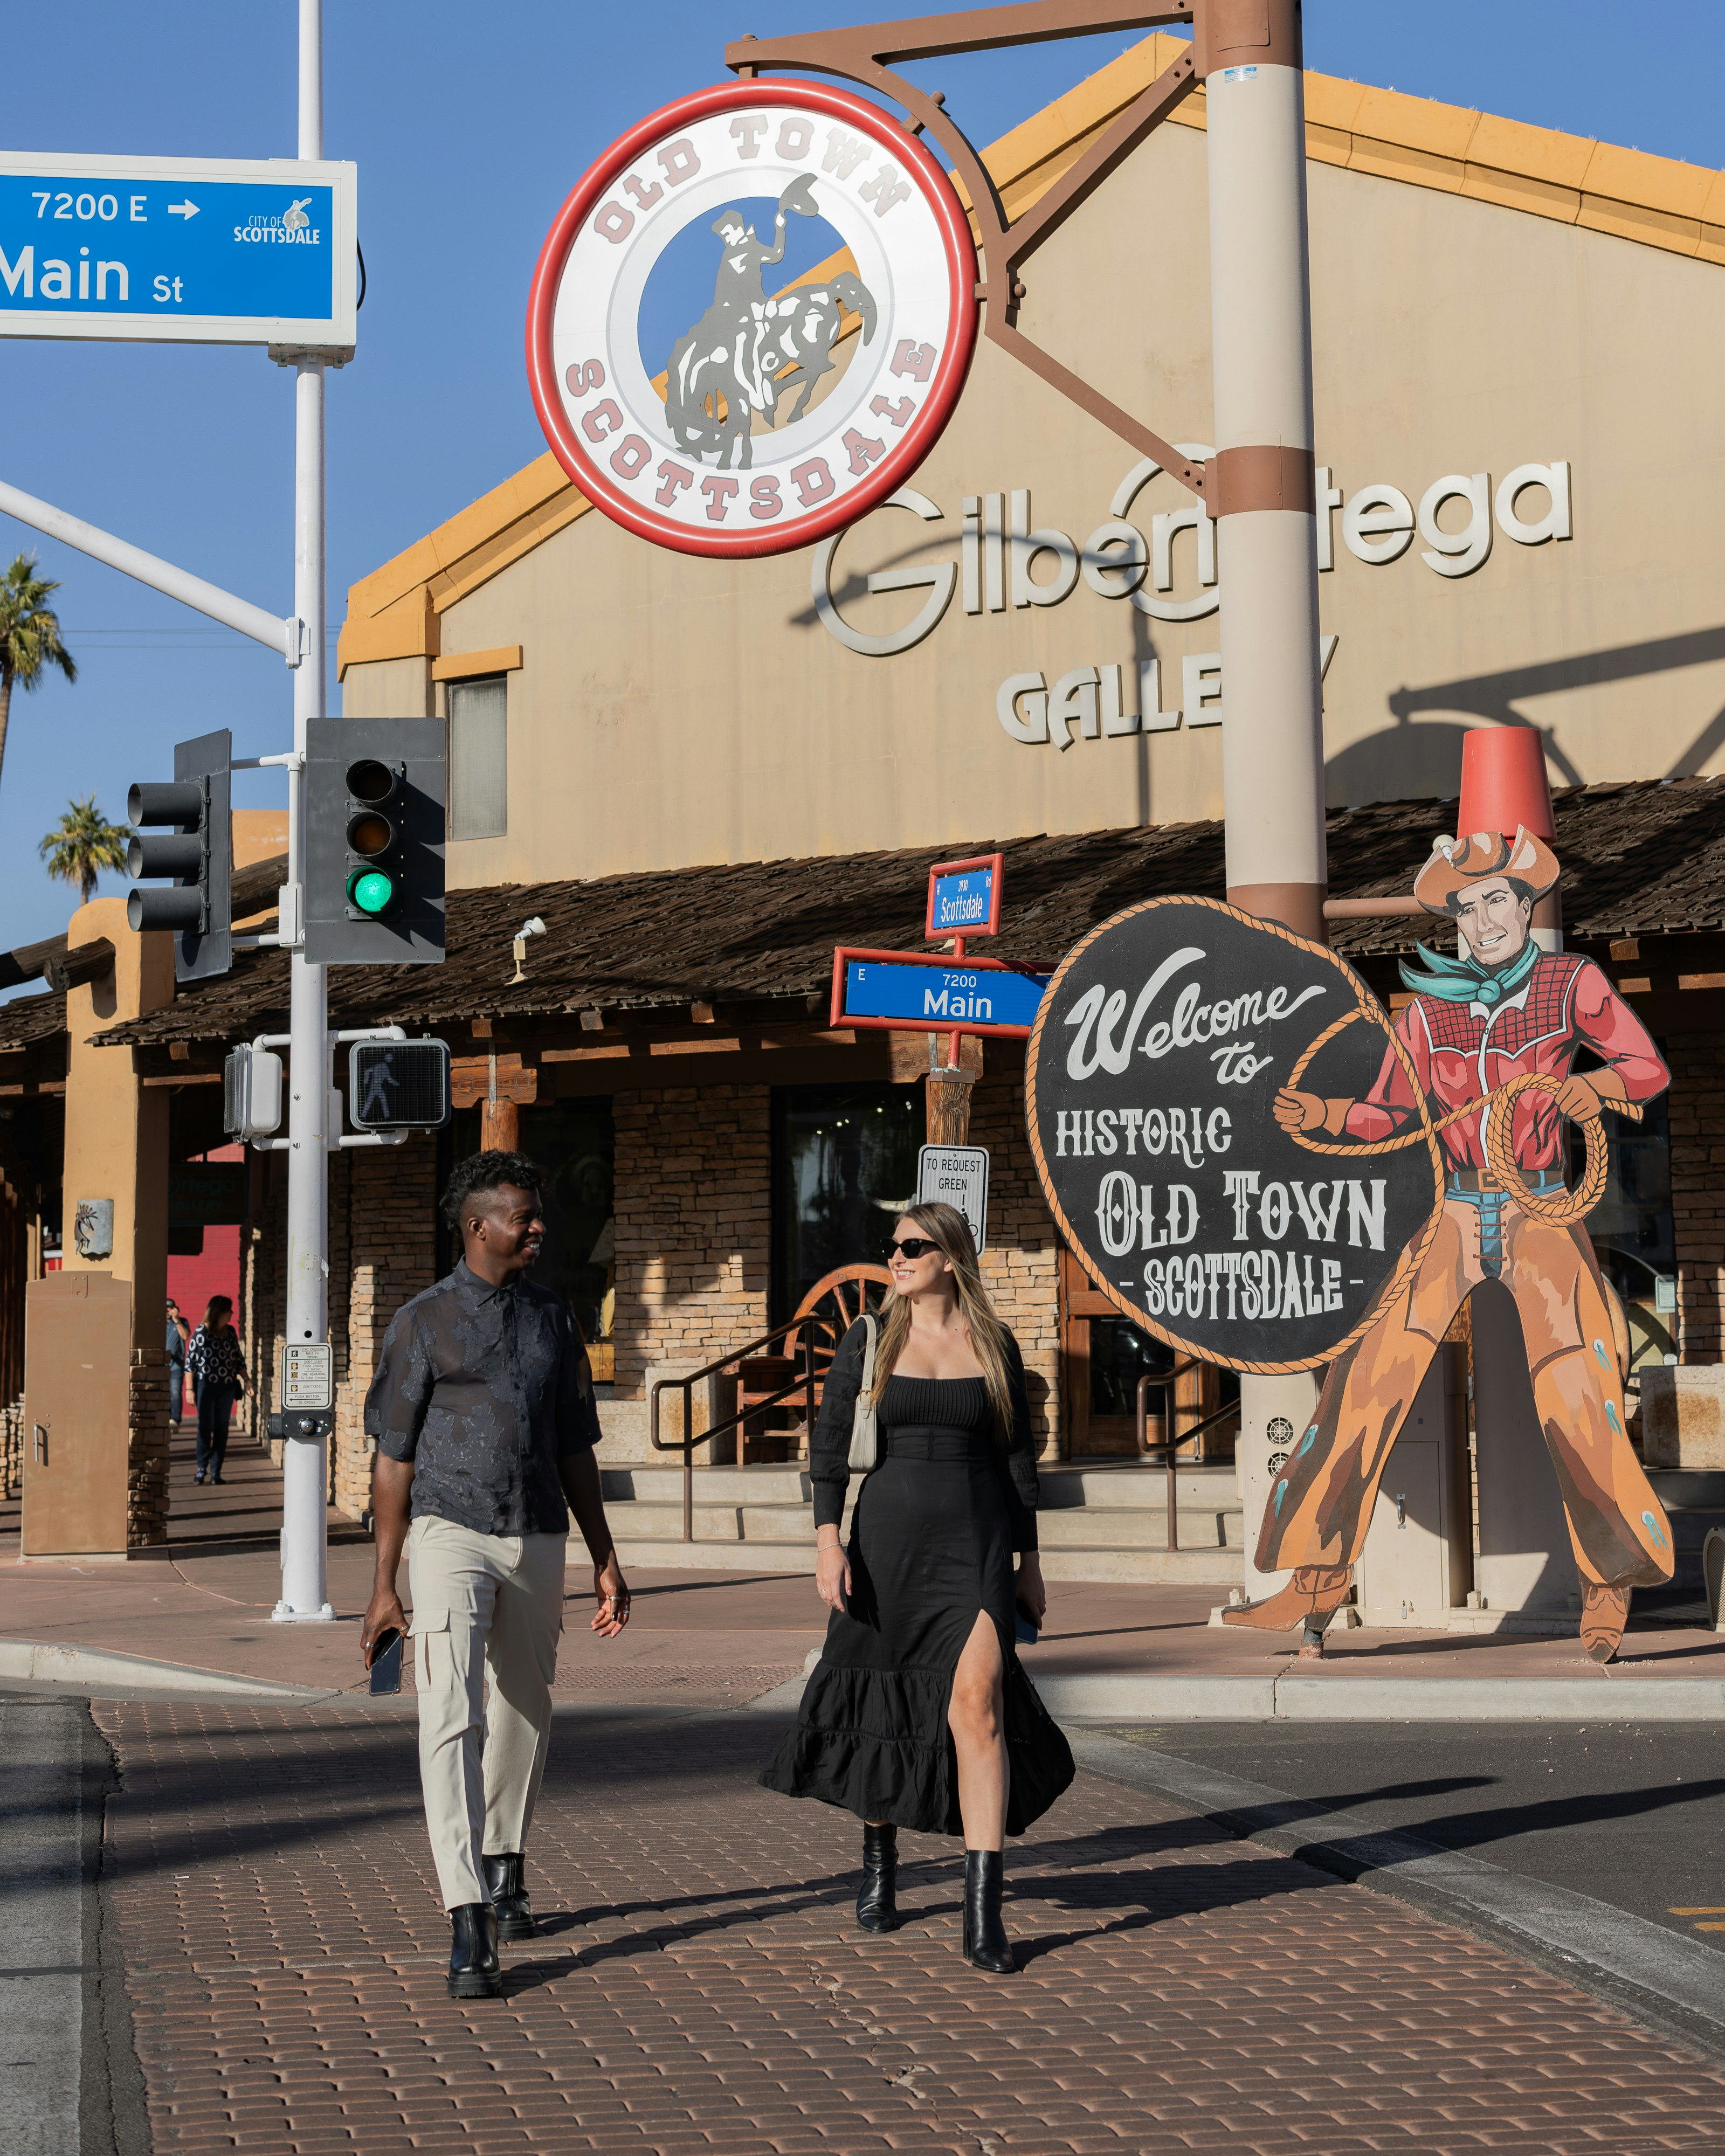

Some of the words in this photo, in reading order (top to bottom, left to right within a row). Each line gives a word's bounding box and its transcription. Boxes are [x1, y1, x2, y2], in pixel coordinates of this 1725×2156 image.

[594, 139, 701, 244] OLD
[729, 114, 912, 218] TOWN
[31, 192, 118, 220] 7200
[130, 196, 147, 222] E
[249, 216, 267, 227] CITY
[270, 216, 282, 227] OF
[234, 226, 320, 244] SCOTTSDALE
[0, 245, 129, 301] Main
[153, 275, 183, 302] St
[566, 339, 937, 522] SCOTTSDALE
[937, 884, 940, 895] N
[958, 879, 968, 892] 3930
[985, 876, 991, 888] Rd
[941, 893, 983, 923] Scottsdale
[858, 968, 866, 980] E
[942, 973, 977, 988] 7200
[923, 989, 992, 1018] Main
[1065, 947, 1327, 1081] Welcome
[1211, 1041, 1273, 1084] to
[1055, 1107, 1232, 1169] HISTORIC
[927, 1158, 937, 1170] TO
[942, 1159, 981, 1172] REQUEST
[939, 1177, 967, 1190] GREEN
[1143, 1250, 1343, 1321] SCOTTSDALE
